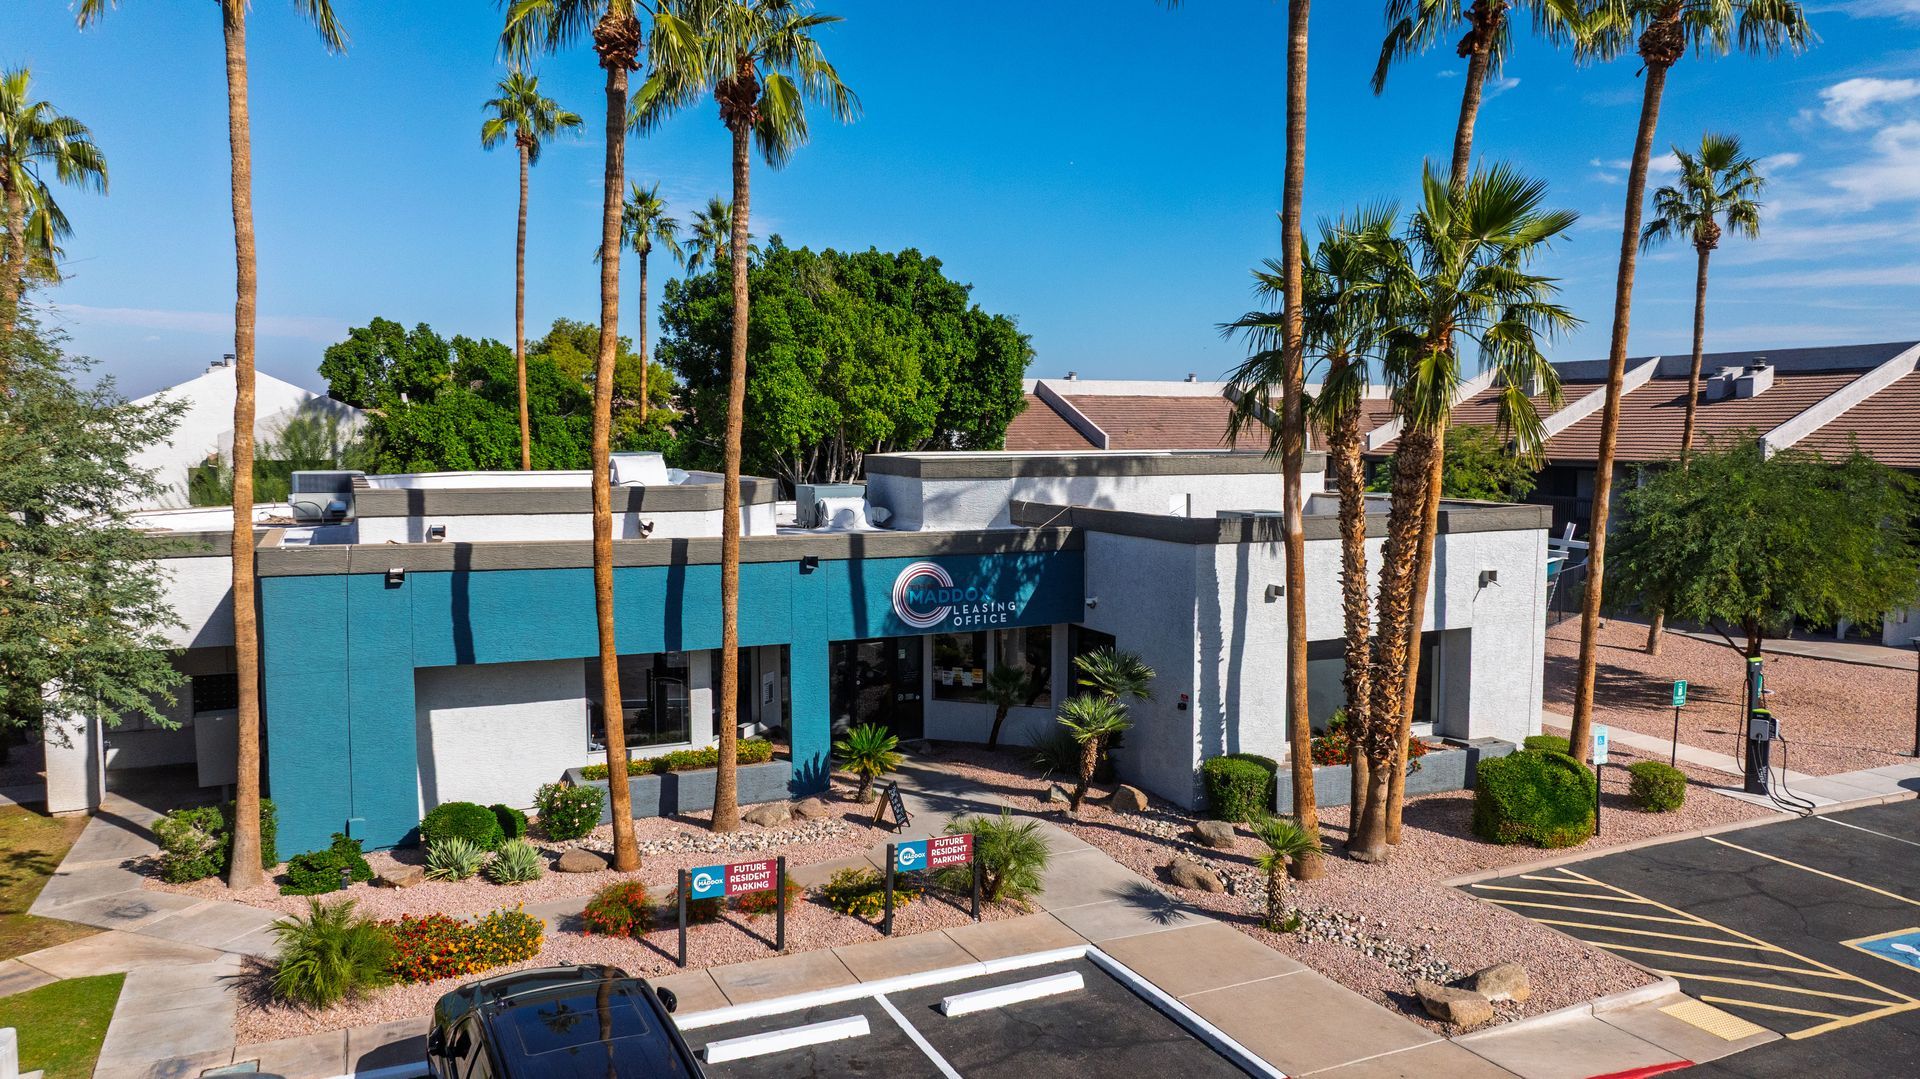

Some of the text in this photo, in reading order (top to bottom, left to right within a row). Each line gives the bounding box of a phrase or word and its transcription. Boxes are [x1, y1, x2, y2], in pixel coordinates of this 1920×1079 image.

[908, 586, 994, 605] MADDOX
[953, 601, 1016, 615] LEASING
[953, 613, 1007, 627] OFFICE
[934, 836, 964, 847] FUTURE
[903, 852, 926, 860] MADDOX
[931, 844, 968, 856] RESIDENT
[932, 853, 966, 865] PARKING
[733, 862, 767, 874] FUTURE
[698, 878, 724, 887] MADDOX
[730, 871, 771, 883] RESIDENT
[732, 880, 769, 892] PARKING
